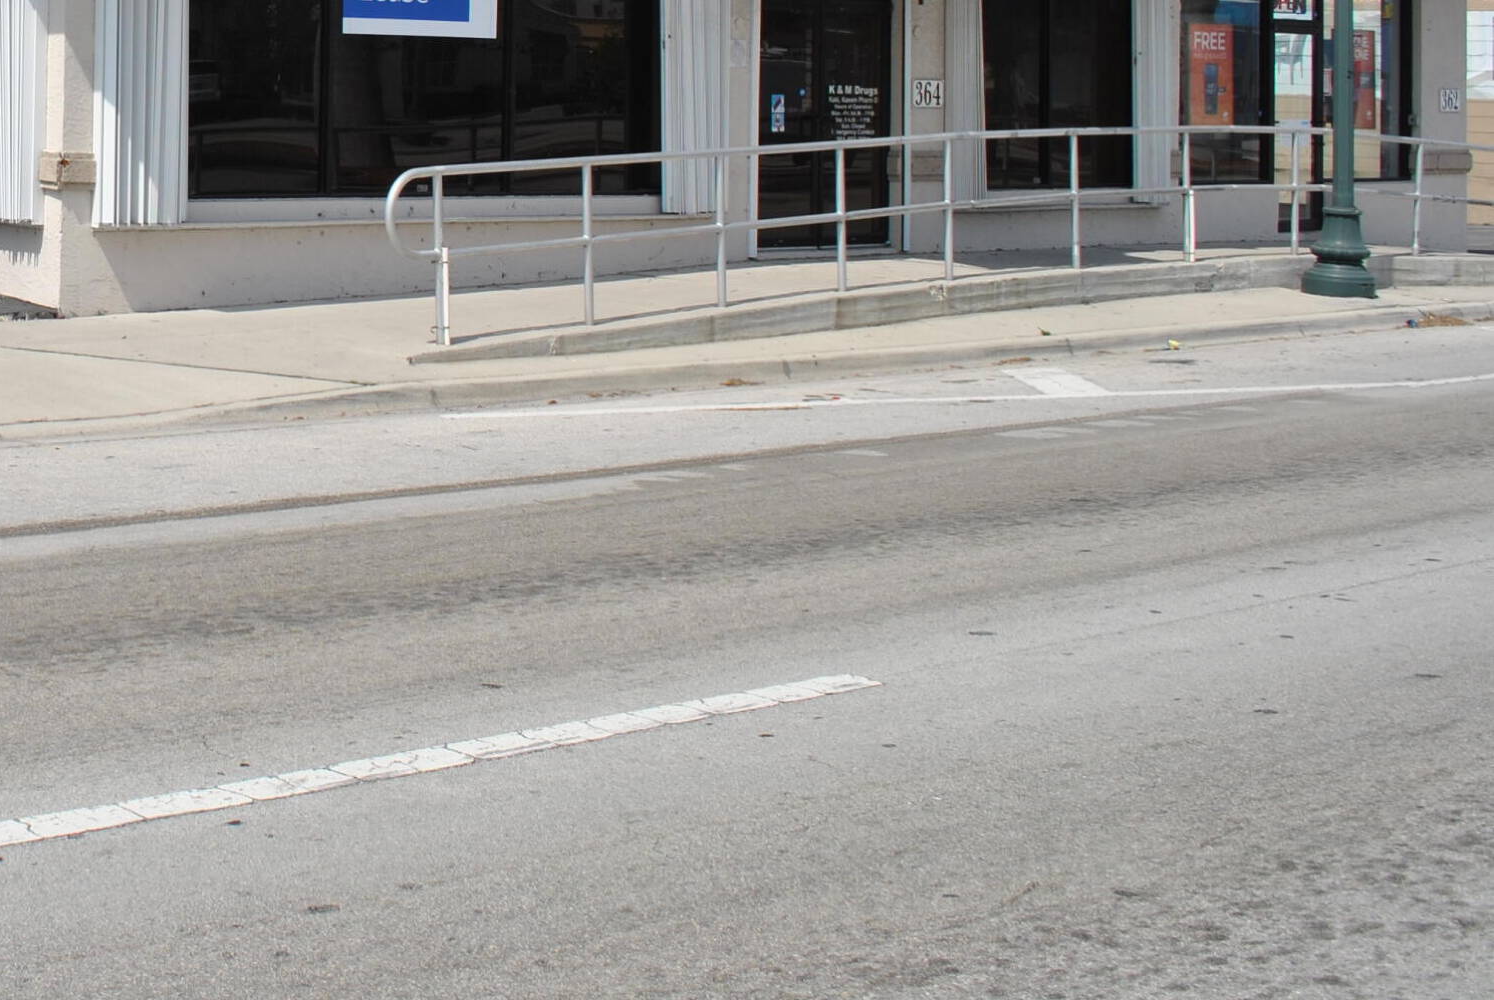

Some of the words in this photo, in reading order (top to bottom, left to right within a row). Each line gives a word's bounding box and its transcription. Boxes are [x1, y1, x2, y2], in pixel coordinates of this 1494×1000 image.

[1194, 31, 1226, 51] FREE
[828, 84, 835, 95] K
[836, 84, 843, 95] &
[844, 84, 852, 95] M
[854, 85, 879, 98] Drugs
[915, 81, 941, 106] 364
